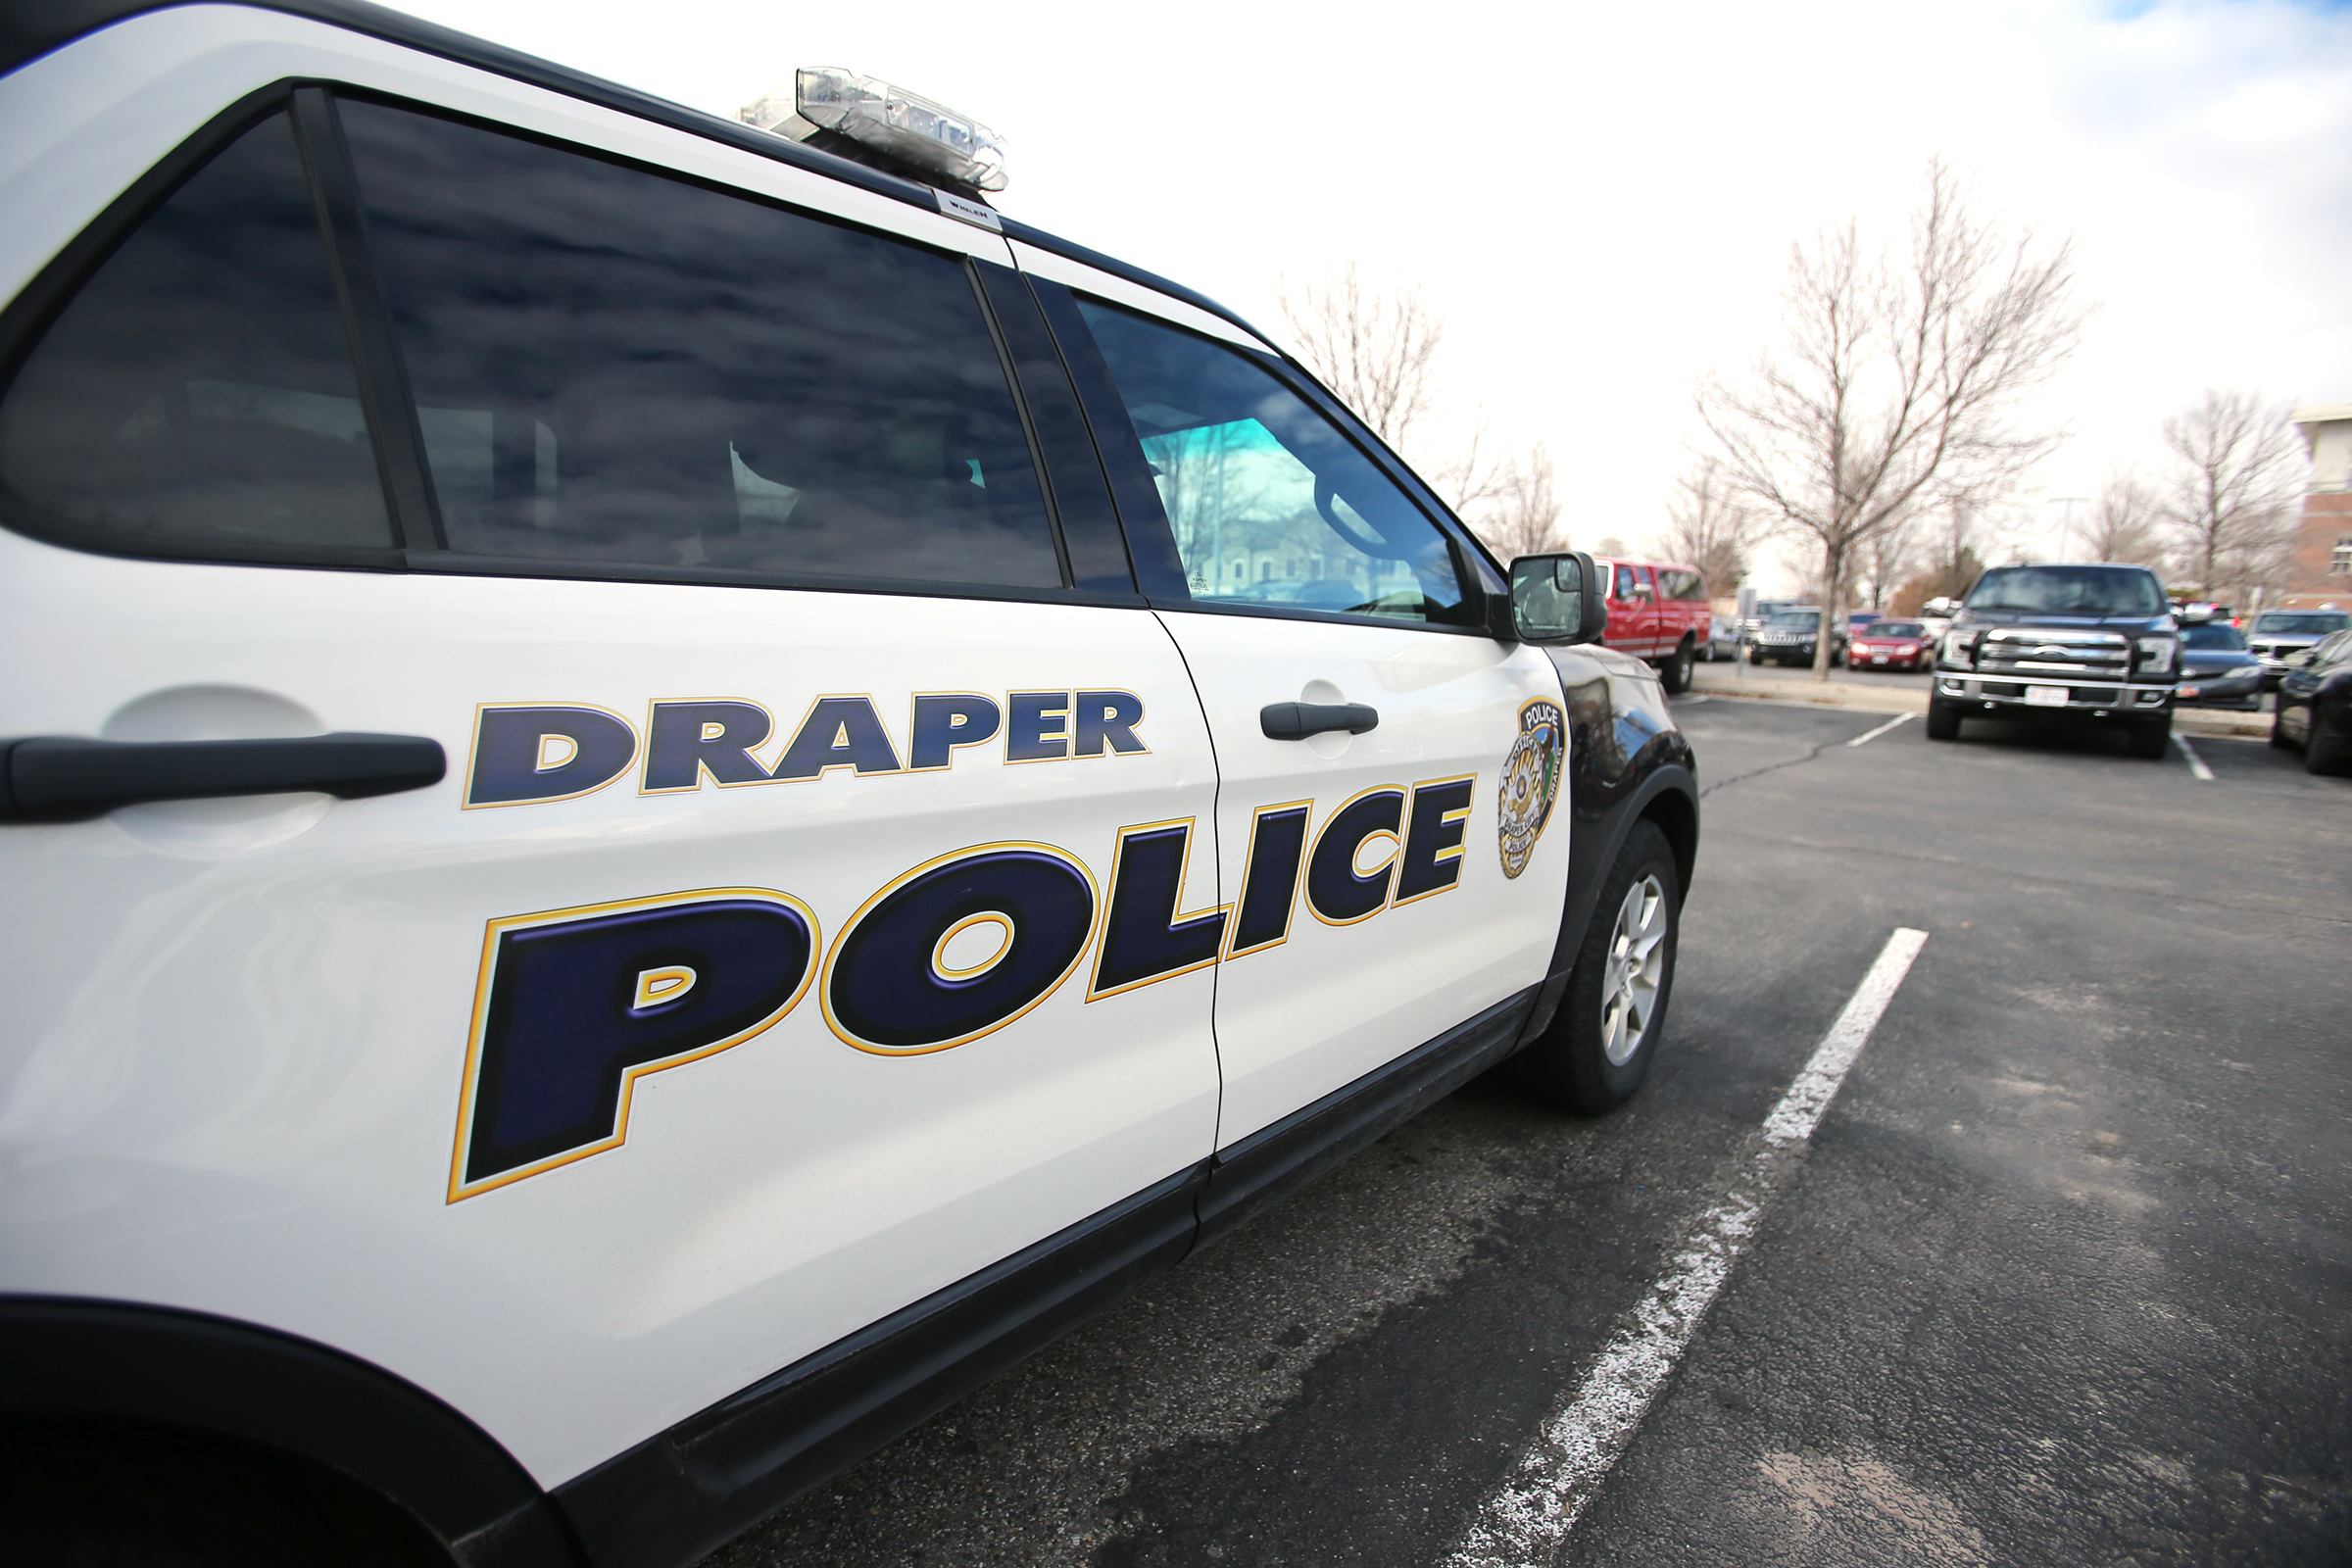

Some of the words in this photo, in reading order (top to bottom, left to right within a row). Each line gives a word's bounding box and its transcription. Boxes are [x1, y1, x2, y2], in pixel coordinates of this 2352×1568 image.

[1526, 705, 1558, 729] POLICE
[461, 689, 1152, 810] DRAPER
[1513, 737, 1539, 760] OFFICER
[1549, 747, 1564, 802] DRAPER
[1504, 817, 1524, 835] DRAPER
[1509, 839, 1528, 851] POLICE
[446, 773, 1478, 1205] POLICE
